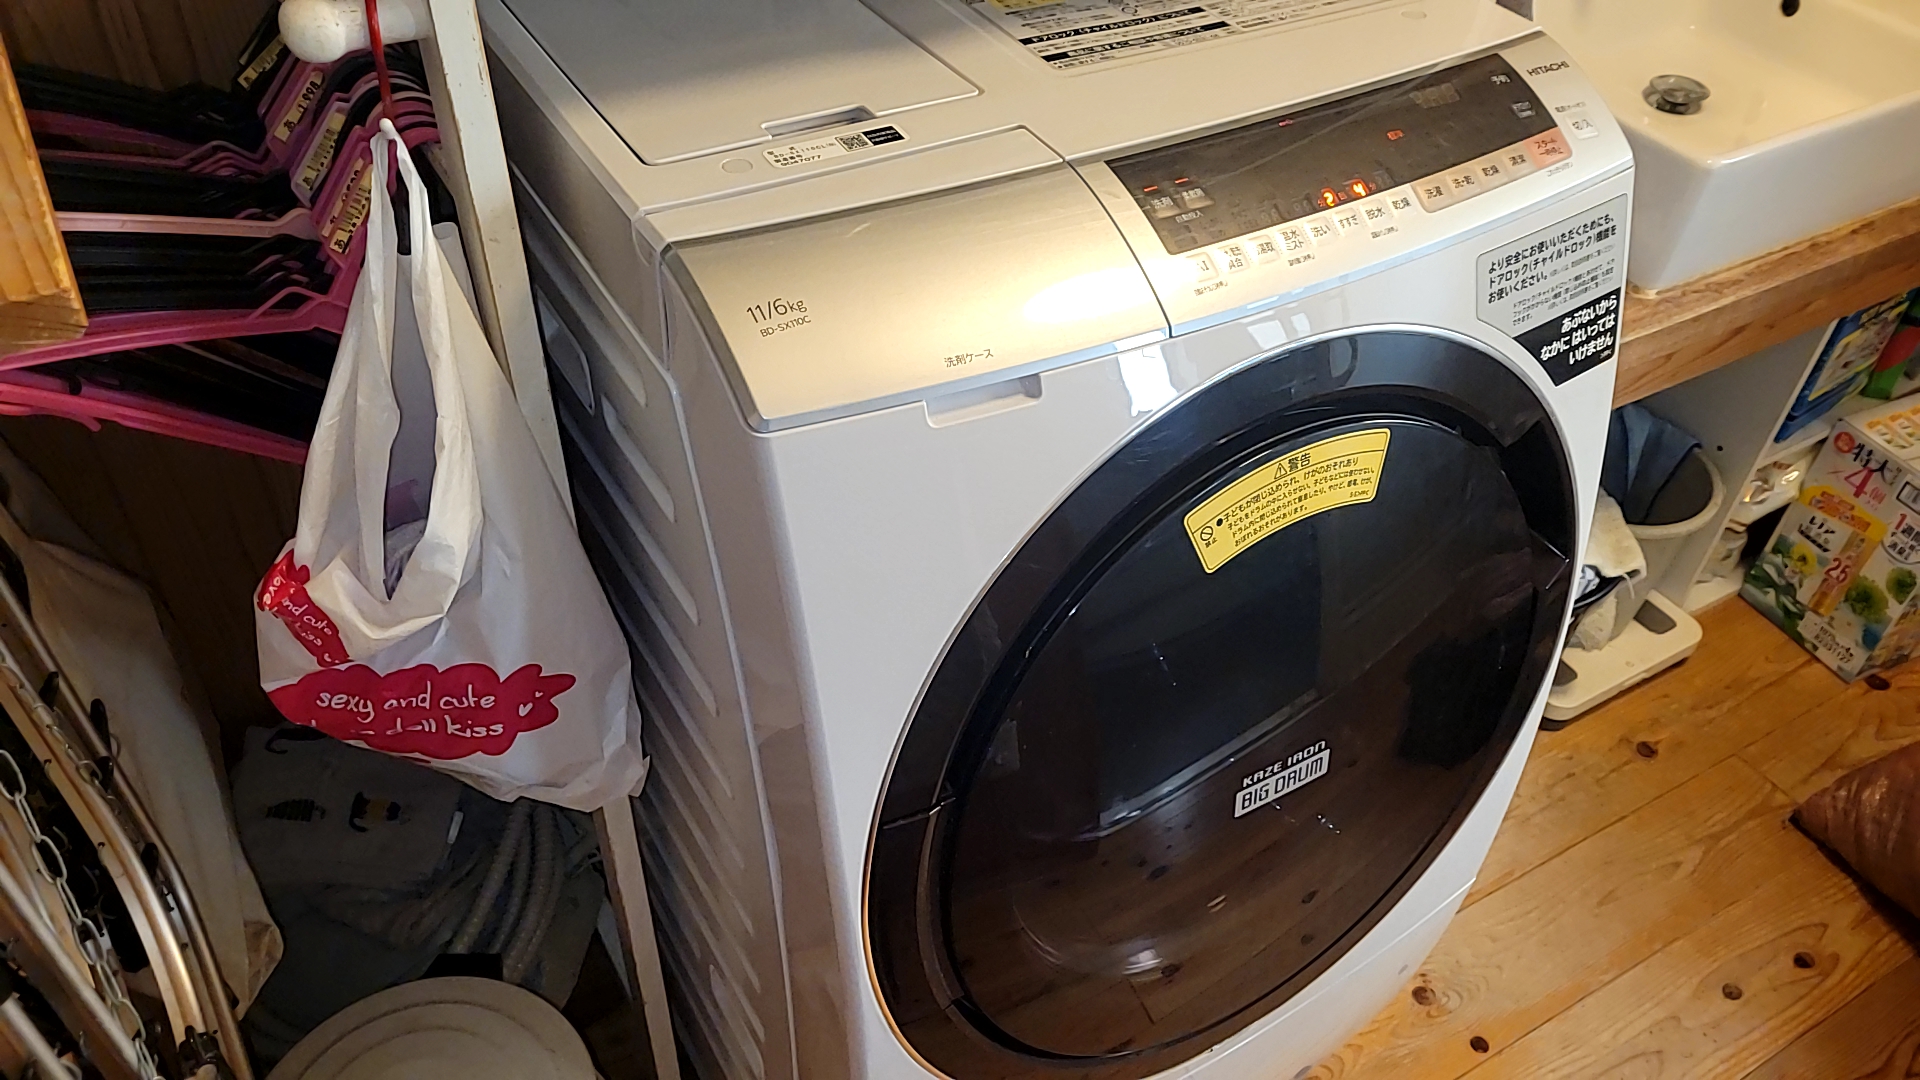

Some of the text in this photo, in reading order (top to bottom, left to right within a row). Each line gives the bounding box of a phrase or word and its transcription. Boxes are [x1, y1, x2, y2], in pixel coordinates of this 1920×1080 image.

[1526, 61, 1570, 77] HITACHI
[1488, 213, 1615, 275] より安全にお使いいただくためにも、
[1488, 271, 1548, 304] お使いください。
[746, 297, 808, 324] 11/6kg
[1560, 294, 1617, 334] あぶないから
[759, 315, 812, 338] BD-SX110C
[1540, 337, 1571, 361] なかに
[1571, 313, 1616, 347] はいっては
[943, 348, 994, 368] 洗剤ケース
[1568, 331, 1614, 365] いけません
[1287, 452, 1312, 473] 警告
[302, 611, 333, 636] cute
[316, 680, 496, 723] sexy and cute
[444, 714, 504, 737] kiss
[1242, 760, 1284, 788] KAZE
[1241, 782, 1270, 811] BIG
